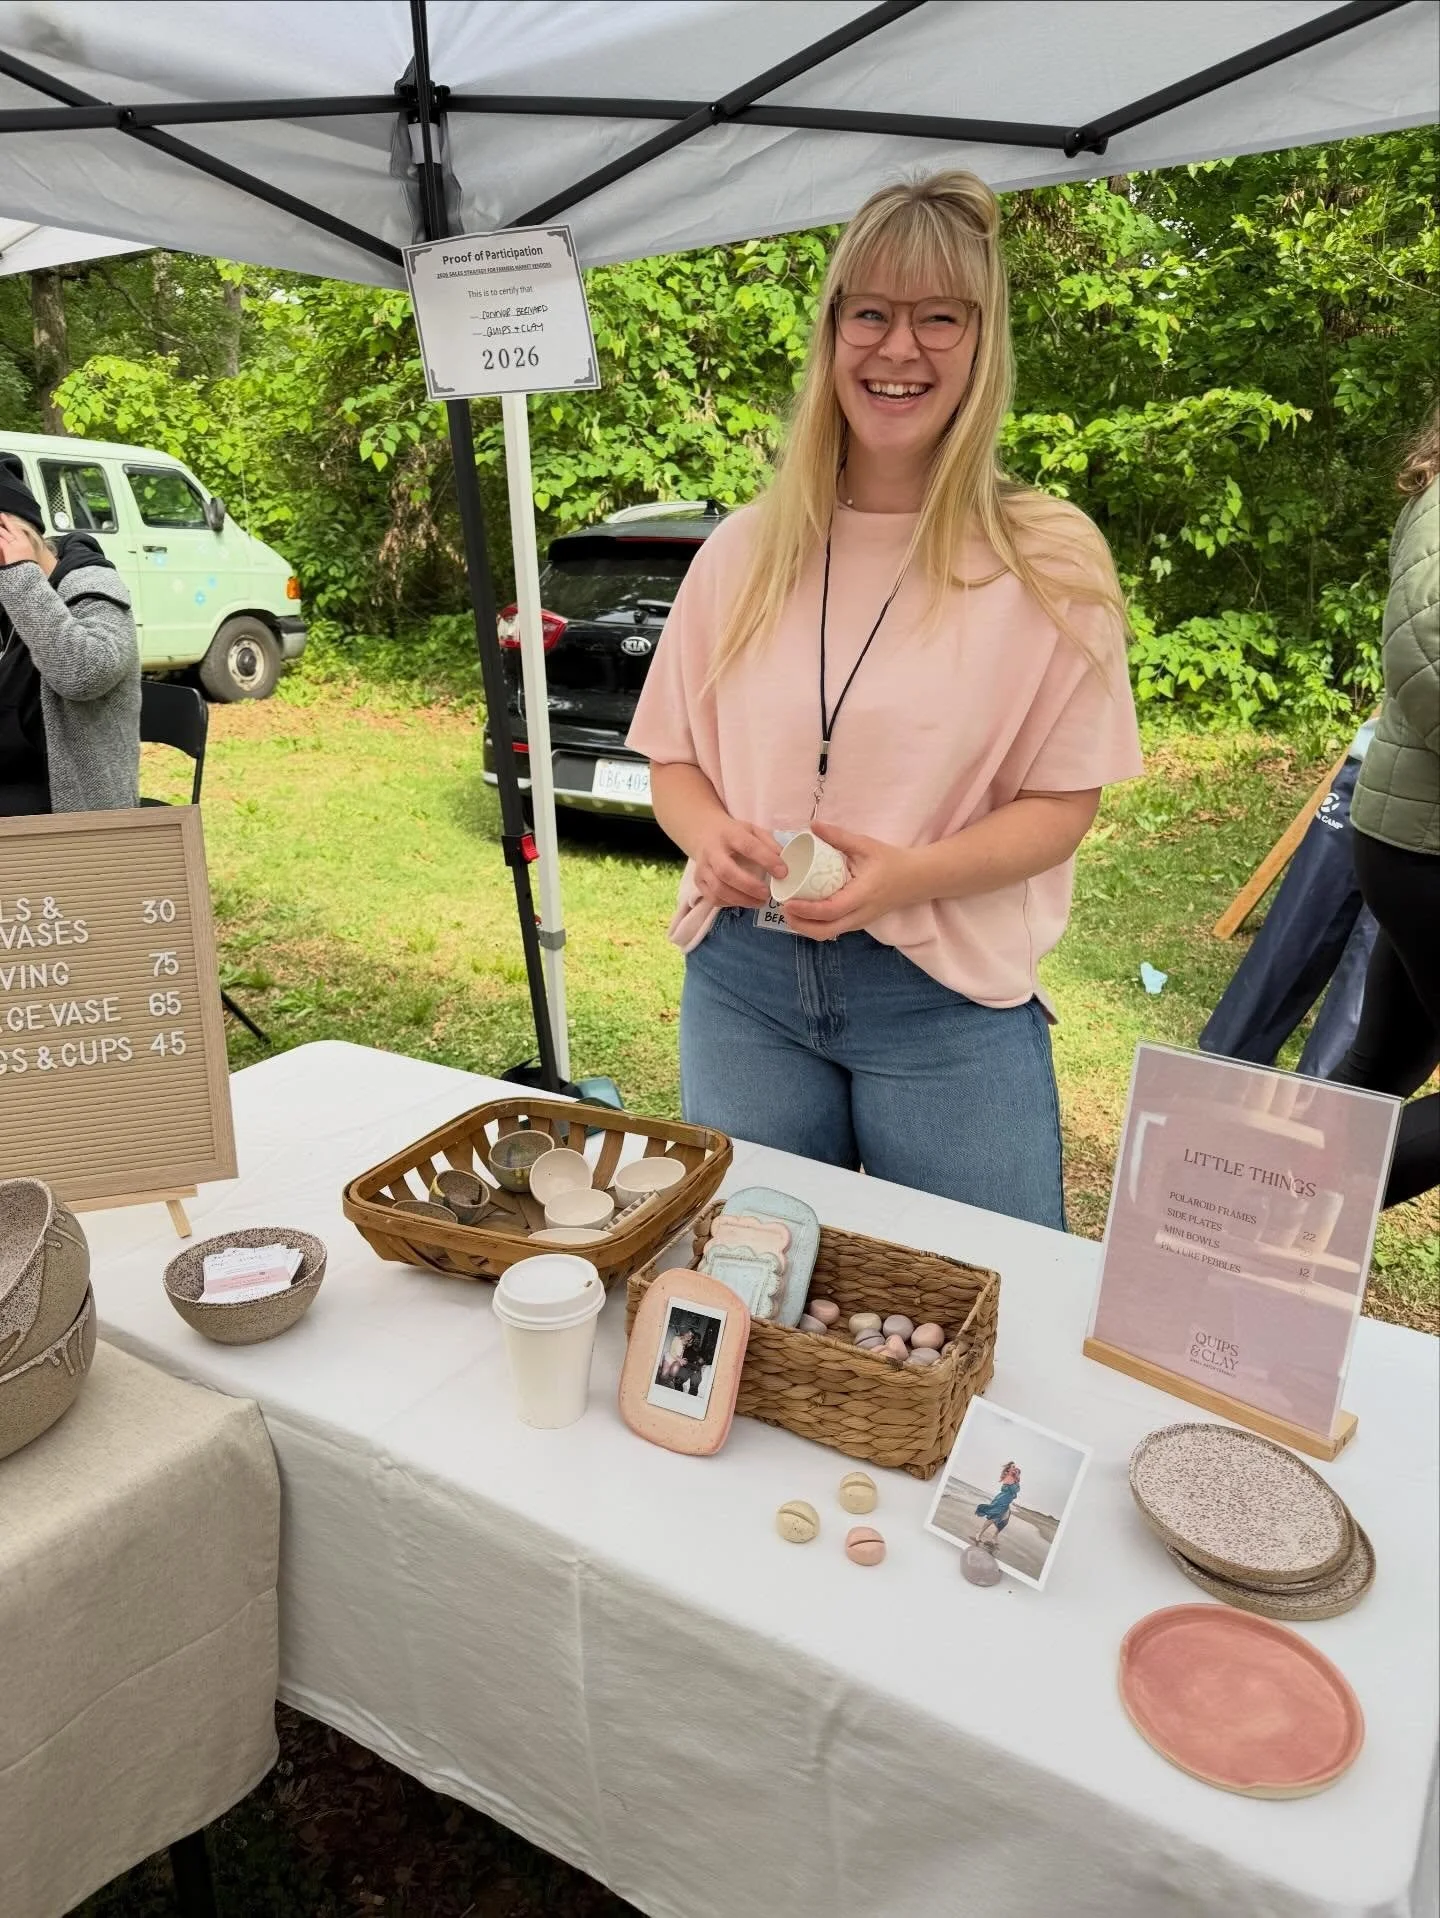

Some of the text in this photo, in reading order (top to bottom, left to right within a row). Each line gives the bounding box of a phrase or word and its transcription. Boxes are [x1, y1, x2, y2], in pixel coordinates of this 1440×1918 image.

[442, 246, 543, 265] Proof of Participation
[468, 290, 482, 298] This
[499, 286, 519, 296] certify
[520, 285, 533, 294] that
[482, 345, 539, 370] 2026
[622, 639, 648, 652] KIA
[43, 896, 64, 920] &
[142, 899, 176, 924] 30
[0, 919, 89, 950] VASES
[149, 951, 180, 977] 75
[0, 990, 182, 1034] GE VASE 65
[37, 1046, 58, 1071] &
[61, 1036, 133, 1067] CUPS
[150, 1030, 187, 1057] 45
[1183, 1148, 1317, 1197] LITTLE THINGS
[1167, 1207, 1223, 1232] SIDE PLATES
[1169, 1191, 1317, 1242] POLAROID FRAMES 22
[1164, 1223, 1311, 1278] MINI BOWLS 12
[1201, 1252, 1241, 1274] PEBBLES
[1195, 1331, 1240, 1356] QUIPS
[1202, 1348, 1240, 1370] CLAY
